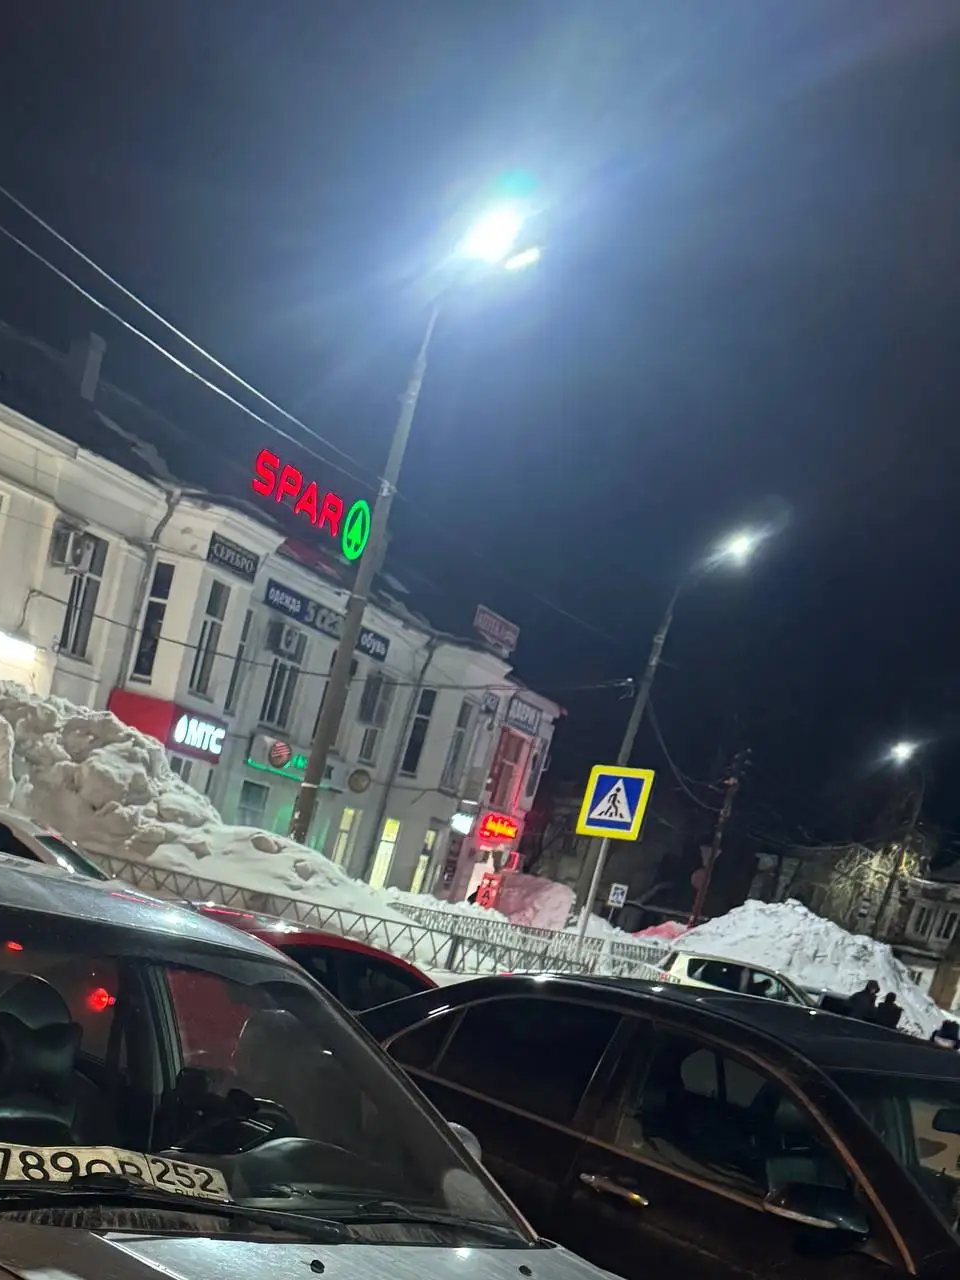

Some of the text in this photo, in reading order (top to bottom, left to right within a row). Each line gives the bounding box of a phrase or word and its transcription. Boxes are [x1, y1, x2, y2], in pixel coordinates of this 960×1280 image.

[251, 449, 344, 537] SPAR
[269, 587, 301, 613] одежда
[361, 633, 386, 657] обувь
[185, 718, 226, 755] МТС
[151, 1158, 220, 1194] 252
